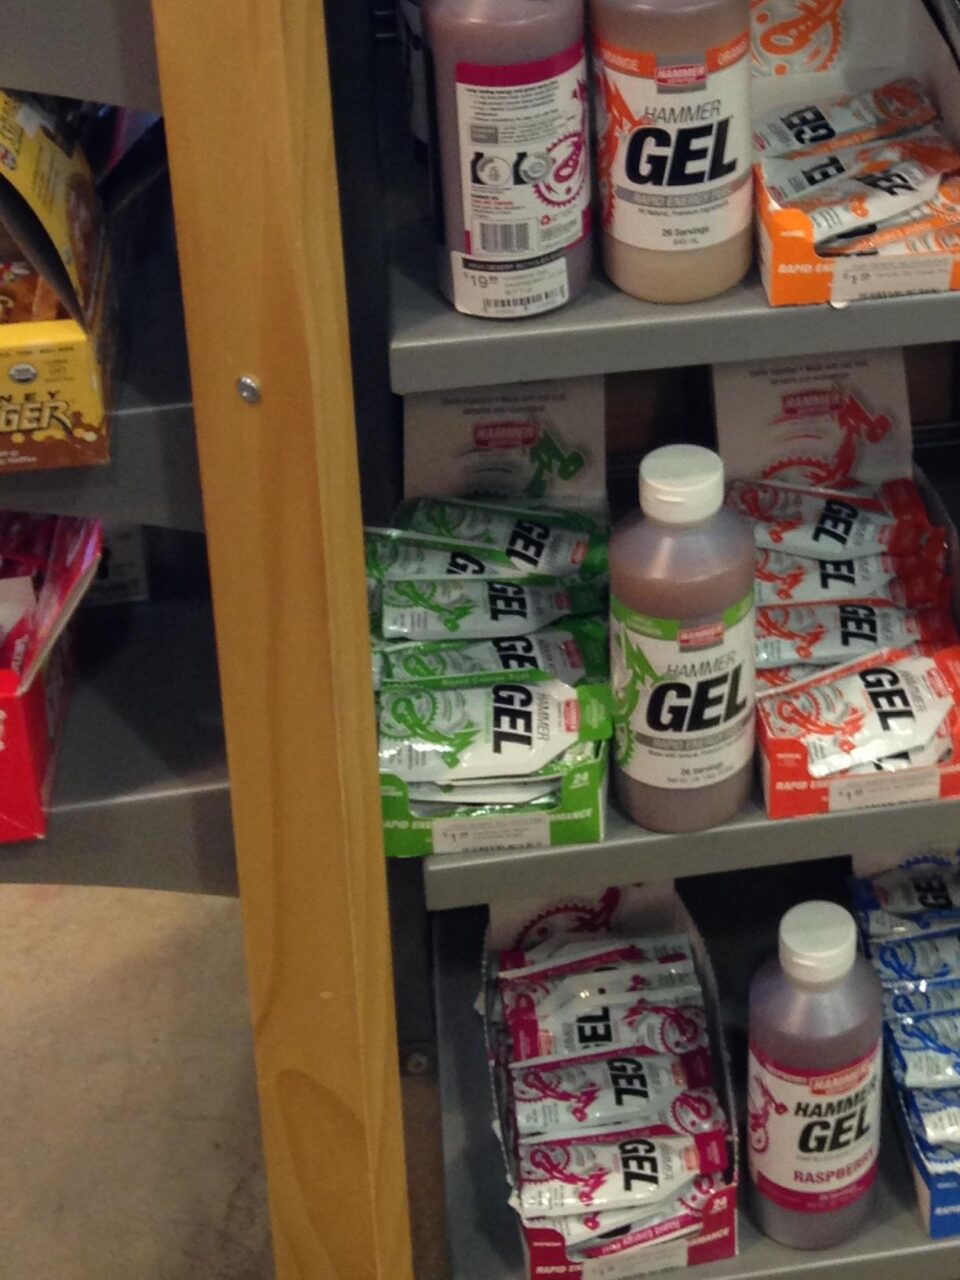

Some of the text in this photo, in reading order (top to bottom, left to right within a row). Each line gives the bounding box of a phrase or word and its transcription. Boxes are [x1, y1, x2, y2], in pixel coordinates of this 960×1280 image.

[643, 99, 721, 124] HAMMER
[625, 115, 738, 187] GEL
[507, 520, 550, 569] GEL
[812, 498, 859, 546] GEL
[819, 559, 857, 589] EL
[488, 581, 528, 623] GEL
[839, 604, 878, 647] GEL
[491, 636, 539, 670] GE
[667, 650, 737, 678] HAMMER
[492, 684, 534, 755] GEL
[536, 691, 551, 741] HAMMER
[646, 662, 748, 733] GEL
[858, 666, 916, 732] GEL
[383, 819, 410, 831] APID
[606, 1057, 650, 1107] GEL
[798, 1104, 870, 1154] GEL
[619, 1139, 659, 1192] GEL
[792, 1149, 873, 1184] RASPBERRY
